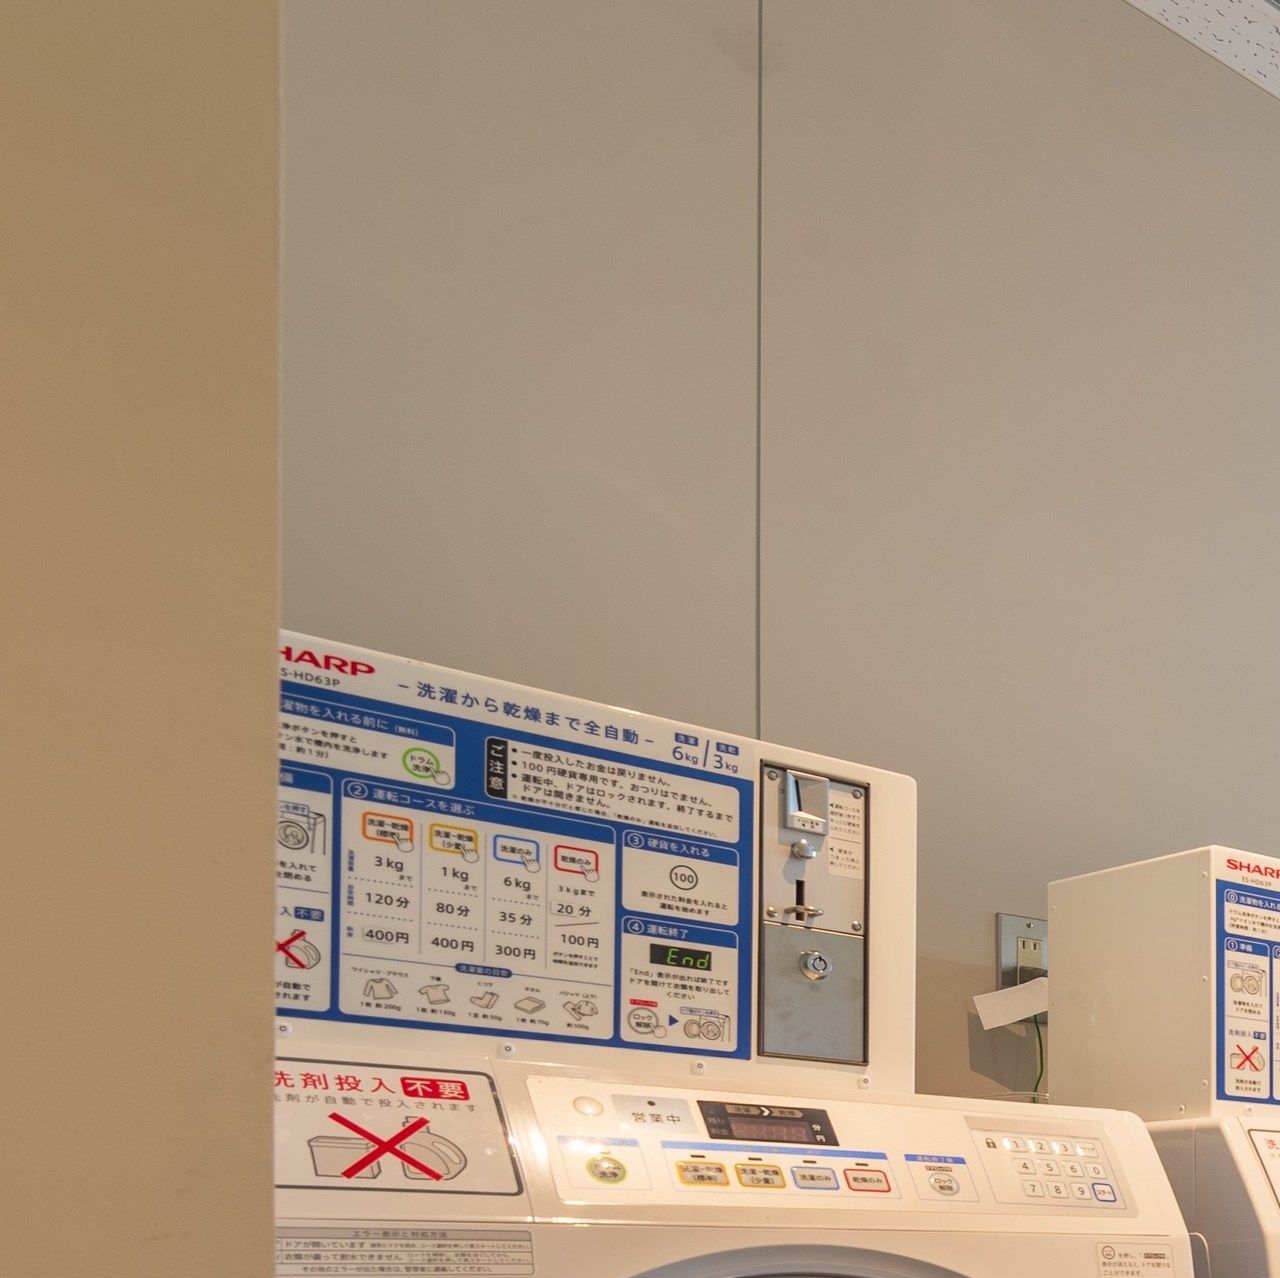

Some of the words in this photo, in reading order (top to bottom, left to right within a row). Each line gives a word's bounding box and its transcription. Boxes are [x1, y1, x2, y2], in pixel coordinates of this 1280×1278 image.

[280, 646, 375, 676] HARP
[280, 668, 340, 687] S-HD63P
[281, 697, 389, 730] 濯物を入れる前に
[666, 947, 710, 970] End
[404, 1078, 468, 1100] 不要
